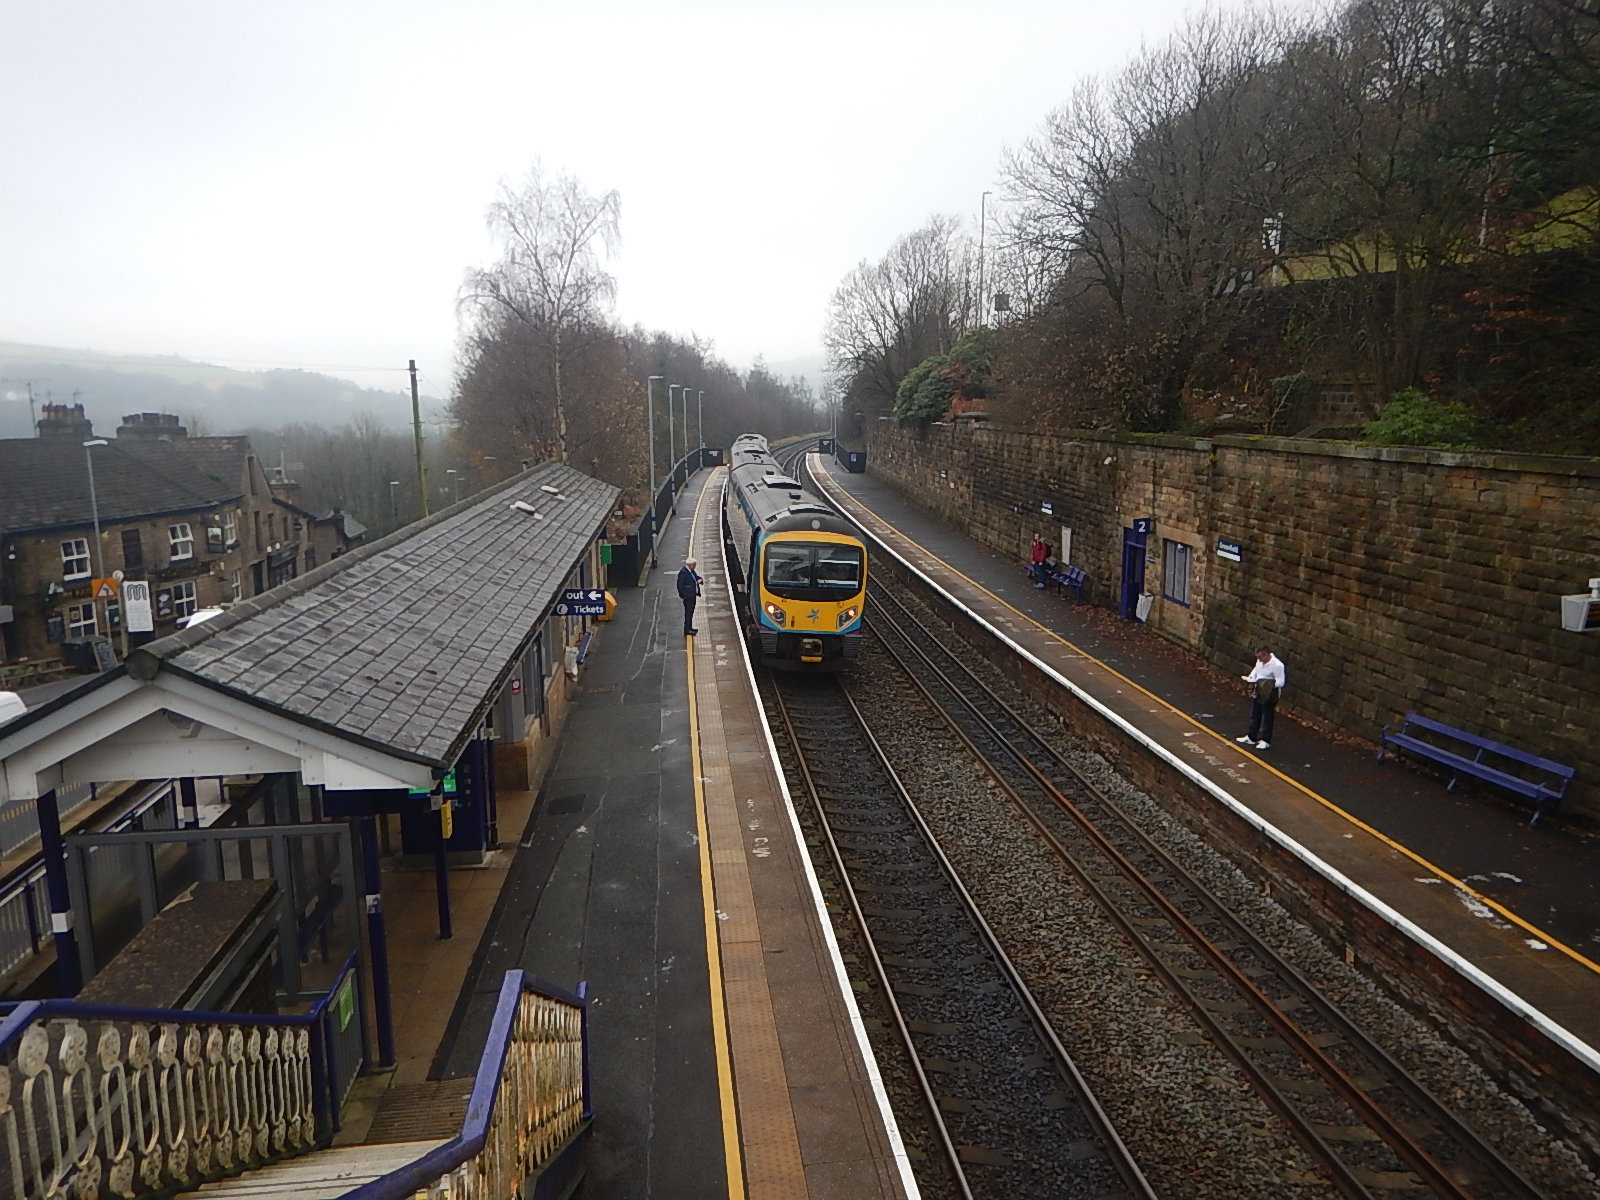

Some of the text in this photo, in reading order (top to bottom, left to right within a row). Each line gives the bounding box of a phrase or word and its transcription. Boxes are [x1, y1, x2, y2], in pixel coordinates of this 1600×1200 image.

[1138, 521, 1146, 533] 2
[566, 591, 584, 600] out
[573, 605, 604, 614] Tickets
